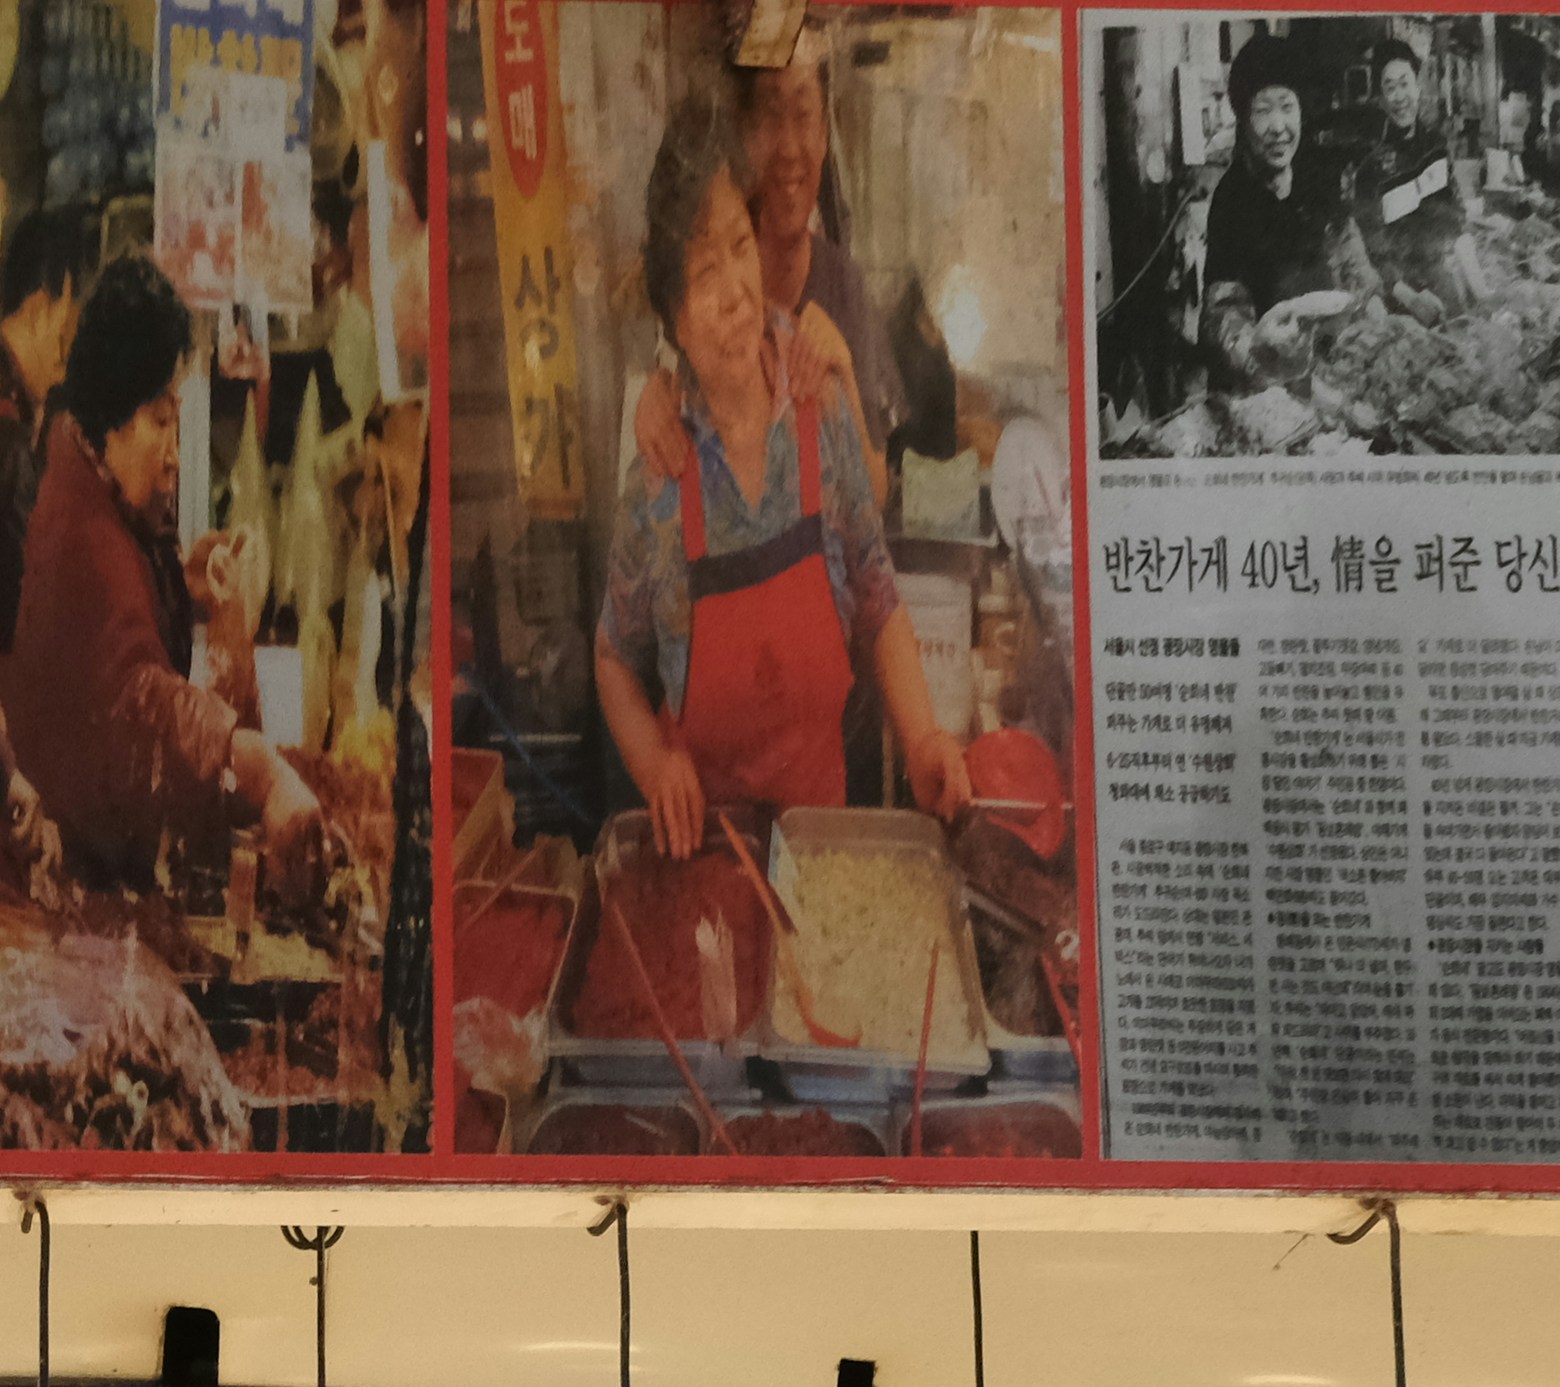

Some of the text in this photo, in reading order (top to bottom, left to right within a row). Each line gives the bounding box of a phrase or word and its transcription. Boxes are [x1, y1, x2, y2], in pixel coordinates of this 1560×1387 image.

[1102, 534, 1229, 596] 반찬가게
[1241, 535, 1322, 597] 40년,
[1331, 534, 1403, 596] 情을
[1413, 535, 1482, 595] 퍼준
